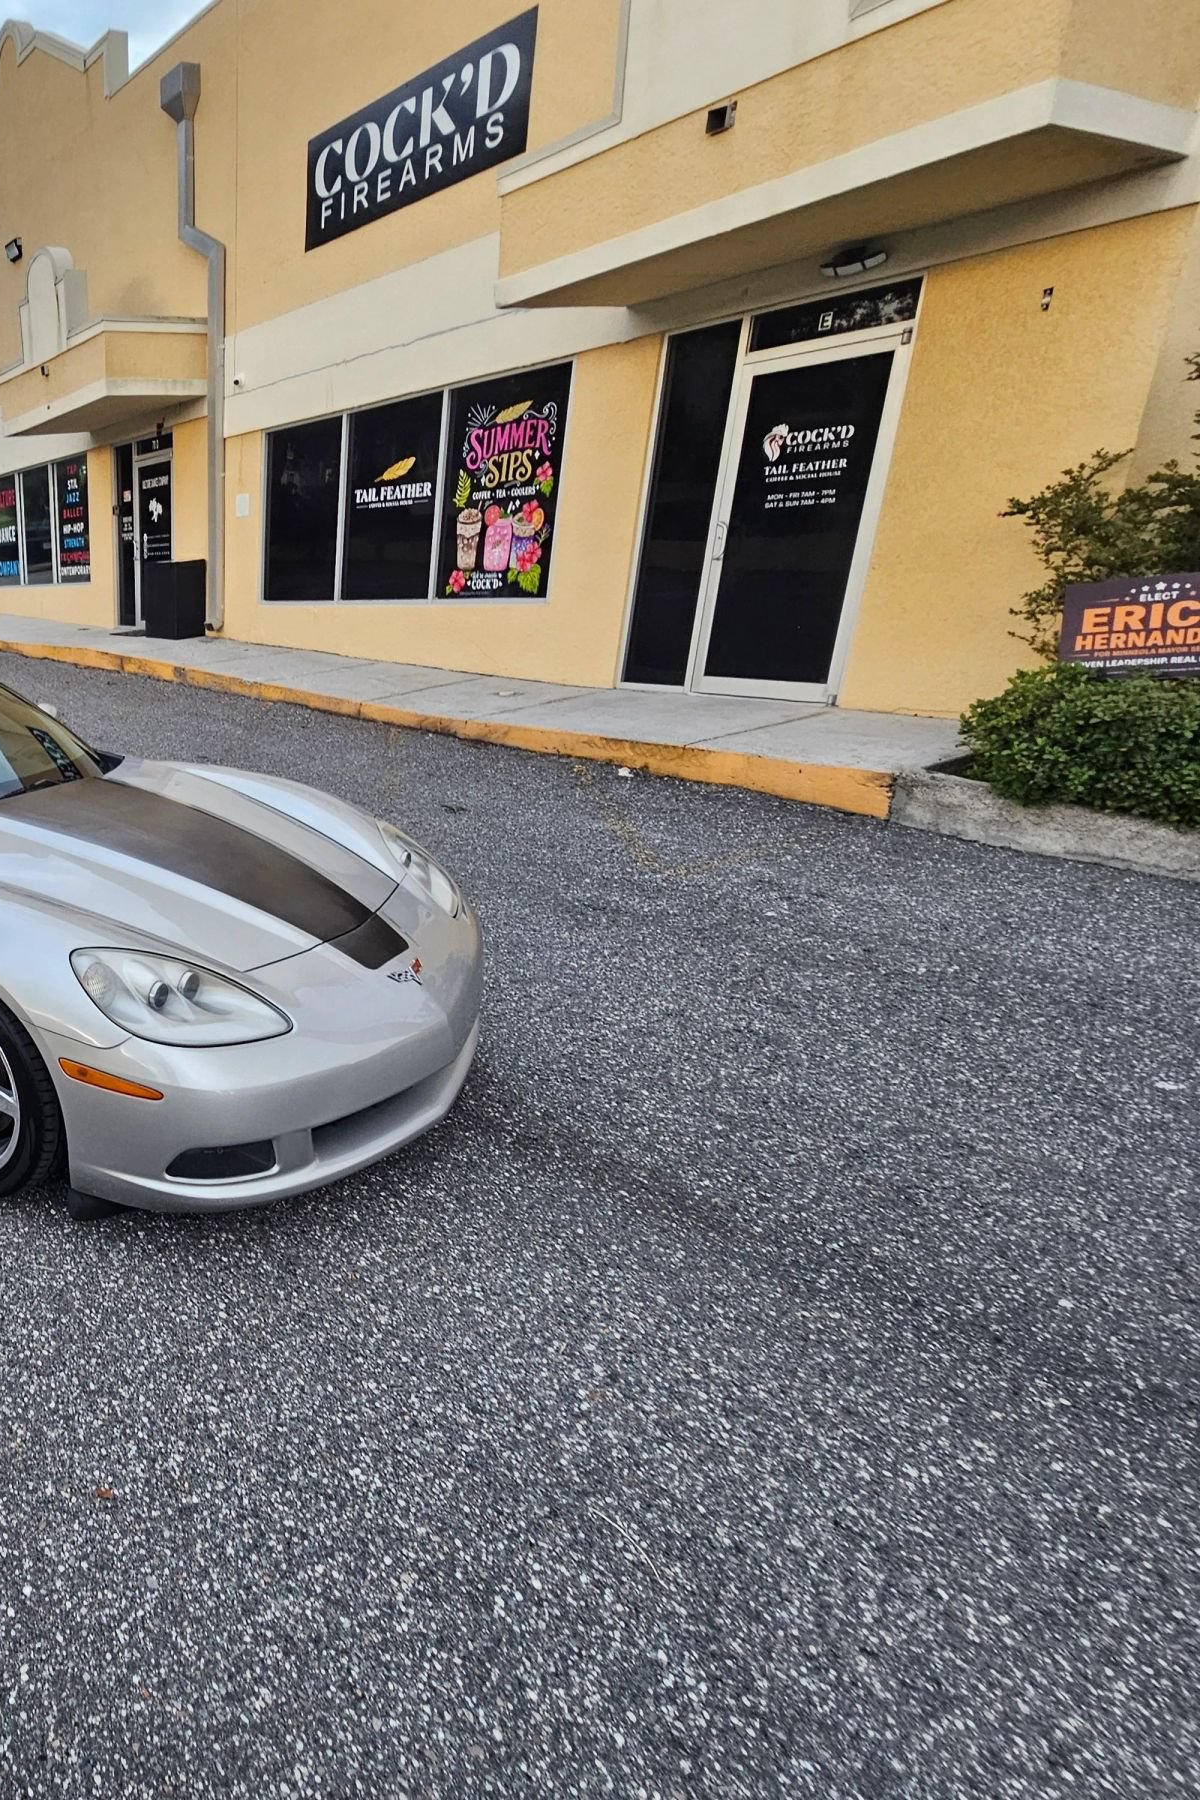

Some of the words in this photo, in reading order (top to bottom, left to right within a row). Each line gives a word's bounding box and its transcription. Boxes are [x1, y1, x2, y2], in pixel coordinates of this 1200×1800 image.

[314, 42, 521, 199] COCK'D
[320, 111, 504, 230] FIREARMS
[786, 424, 855, 446] COCK'D
[465, 419, 552, 470] SUMMER
[786, 439, 850, 454] FIREARMS
[485, 448, 533, 488] SIPS
[763, 464, 789, 476] TAIL
[791, 458, 848, 473] FEATHER
[66, 492, 80, 504] JAZZ
[354, 487, 379, 504] TAIL
[380, 481, 432, 501] FEATHER
[472, 490, 491, 500] COFFEE
[496, 488, 506, 498] TEA
[510, 485, 536, 497] COOLERS
[767, 493, 784, 501] MON
[785, 500, 800, 508] SUN
[63, 506, 84, 519] BALLET
[63, 522, 84, 534] HIP-HOP
[471, 578, 499, 590] COCK'D
[1139, 590, 1180, 602] ELECT
[1080, 600, 1200, 634] ERIC
[1158, 646, 1189, 655] MAYOR
[1170, 655, 1198, 664] REAL
